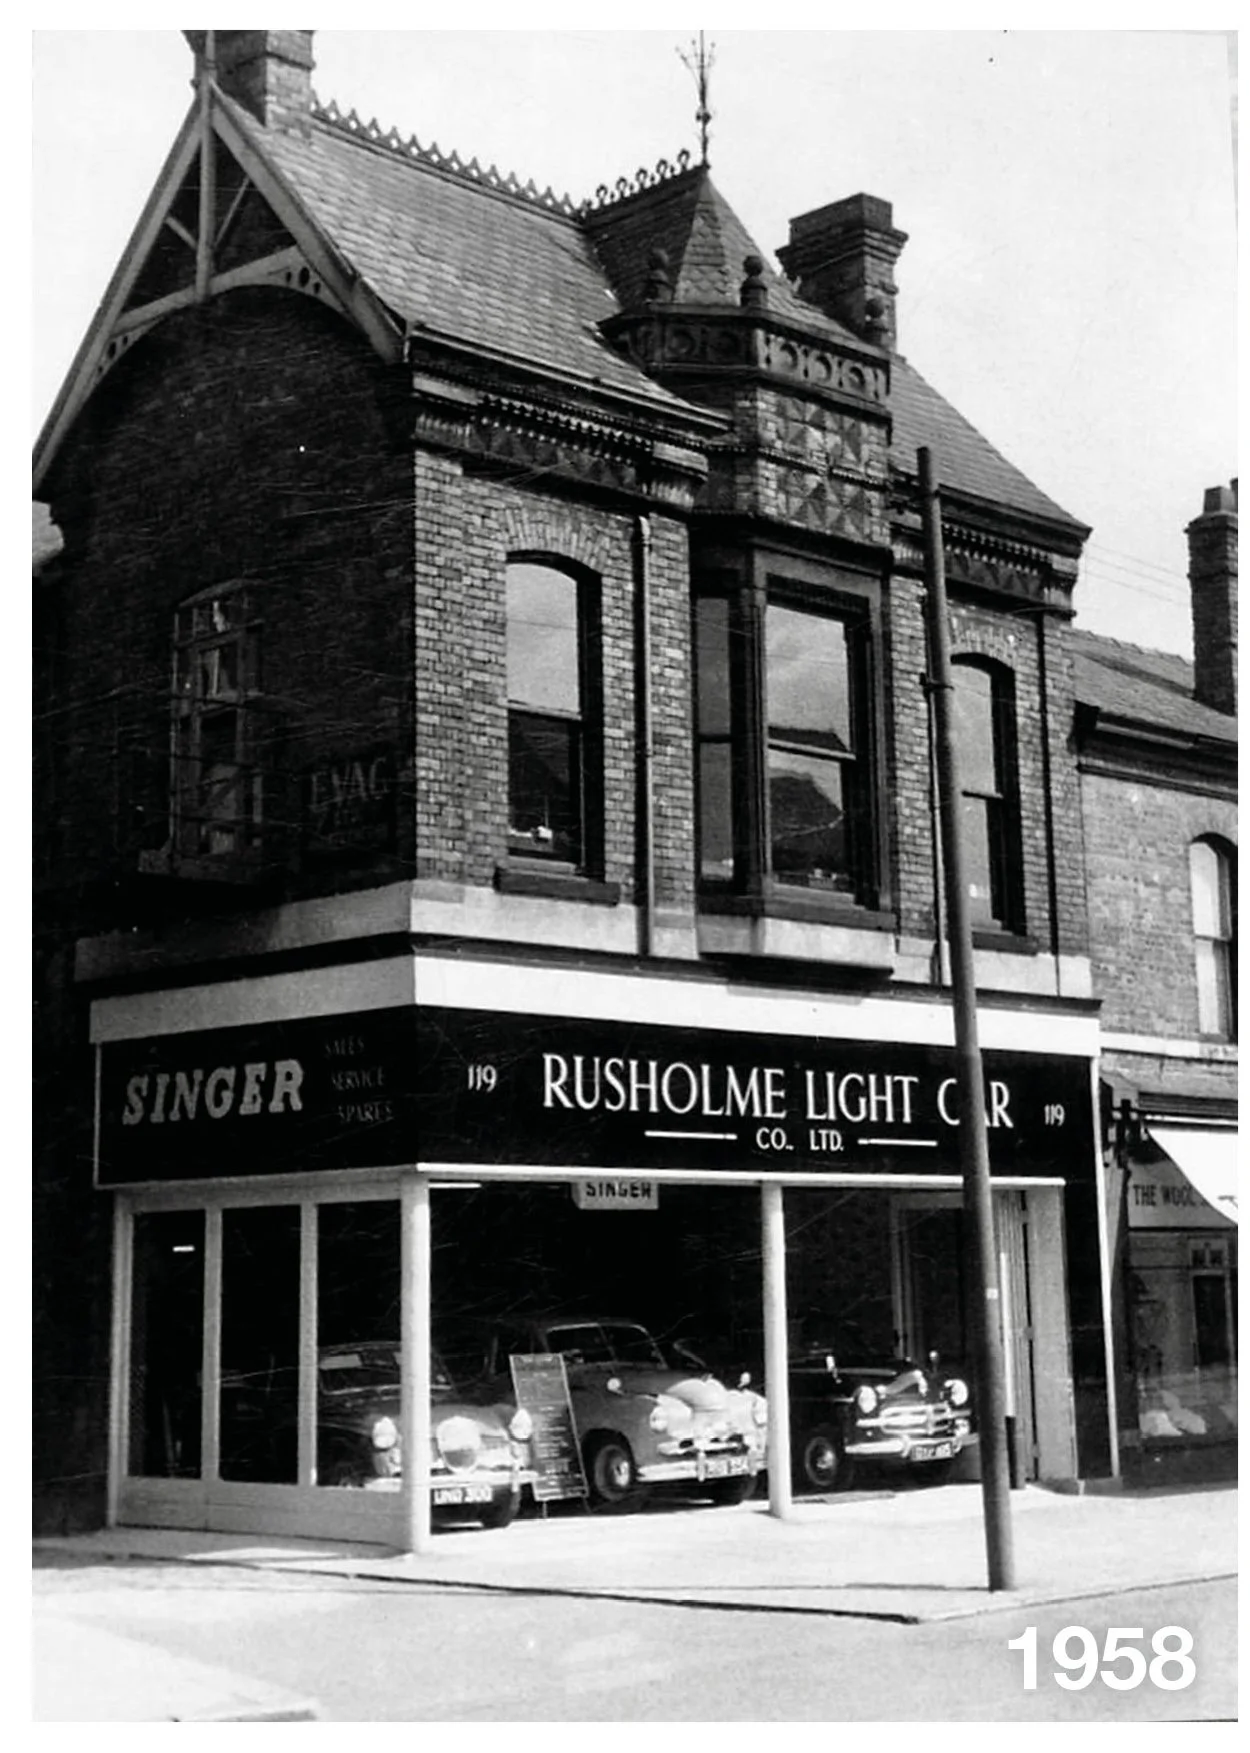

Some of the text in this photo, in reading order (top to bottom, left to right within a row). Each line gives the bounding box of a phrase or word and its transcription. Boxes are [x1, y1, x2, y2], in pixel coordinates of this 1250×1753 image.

[467, 1064, 496, 1092] 119
[122, 1059, 304, 1125] SINGER
[542, 1053, 1014, 1128] RUSHOLME LIGHT CR
[1044, 1104, 1065, 1126] 119
[809, 1128, 844, 1152] LTD.
[586, 1181, 652, 1198] SINGER
[1133, 1184, 1156, 1206] THE
